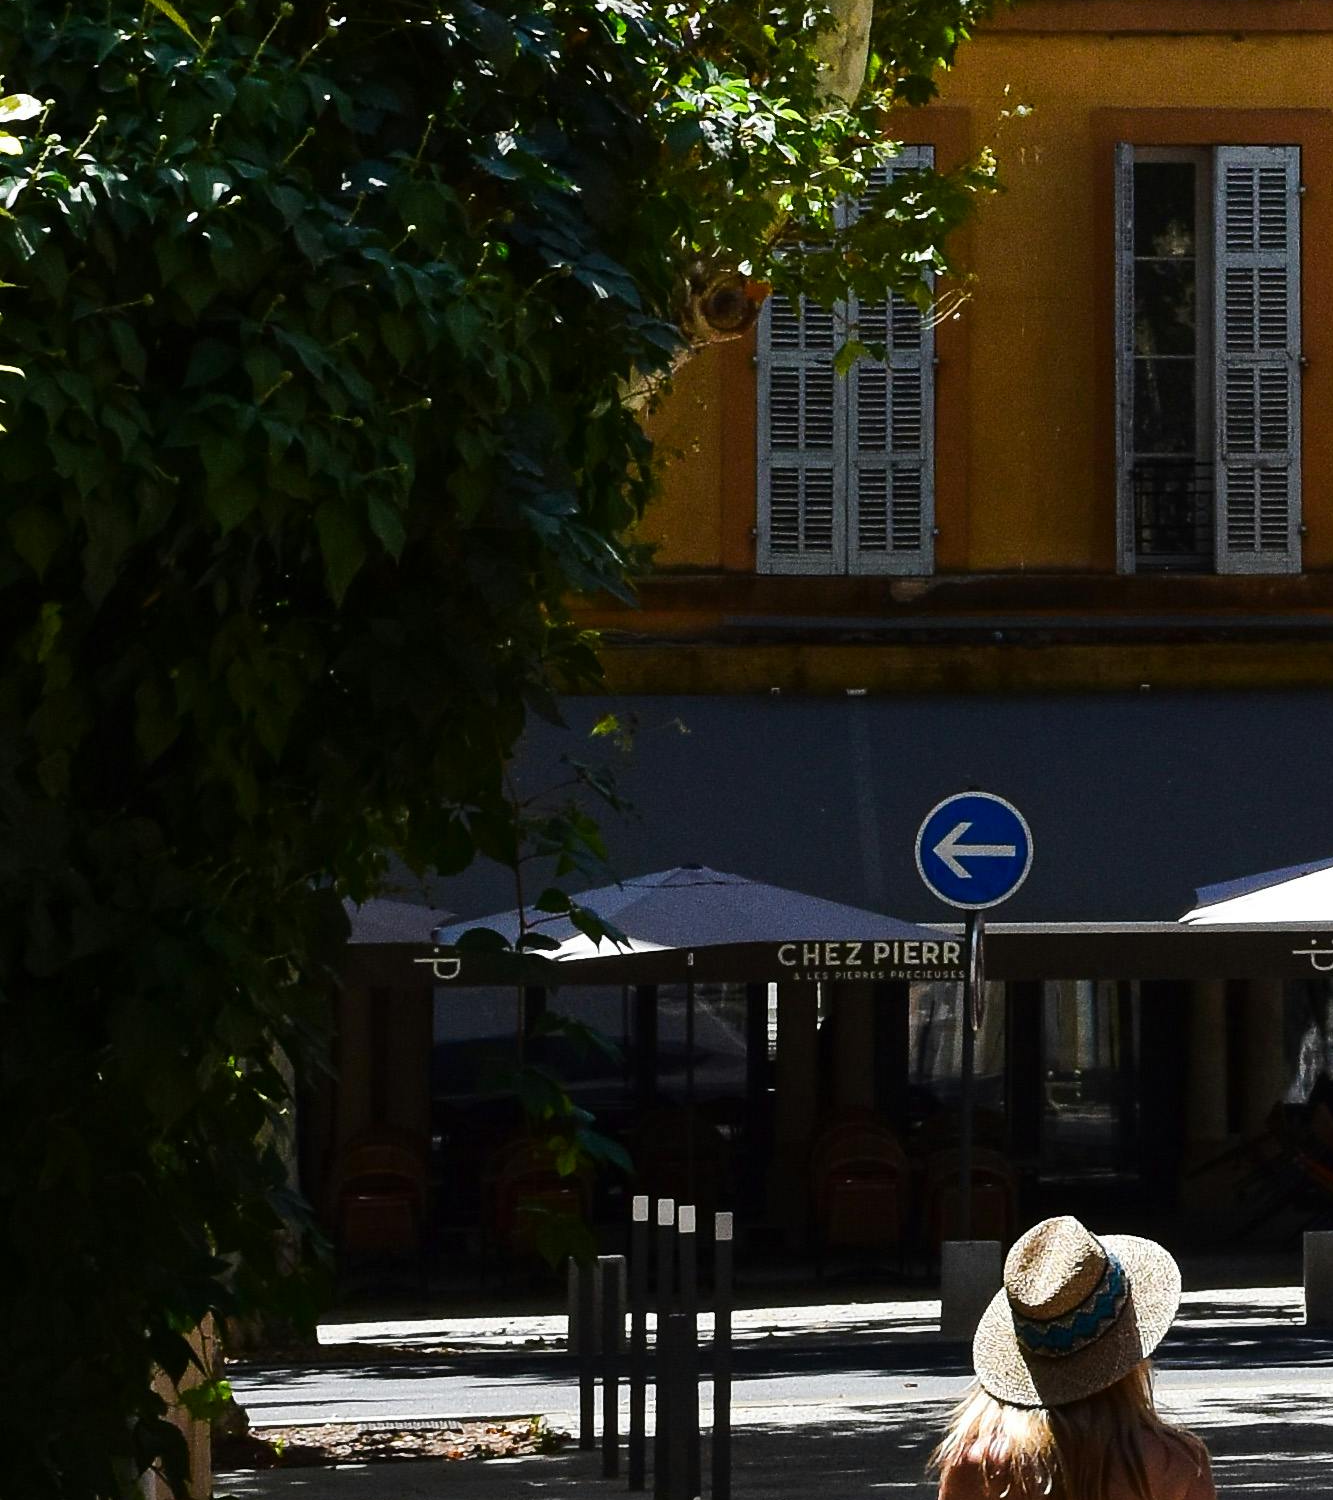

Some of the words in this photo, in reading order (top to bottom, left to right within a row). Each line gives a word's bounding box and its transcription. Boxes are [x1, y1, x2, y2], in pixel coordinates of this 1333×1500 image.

[777, 942, 862, 966] CHEZ
[873, 941, 961, 965] PIERR
[806, 971, 829, 981] LES
[835, 971, 885, 980] PIERRES
